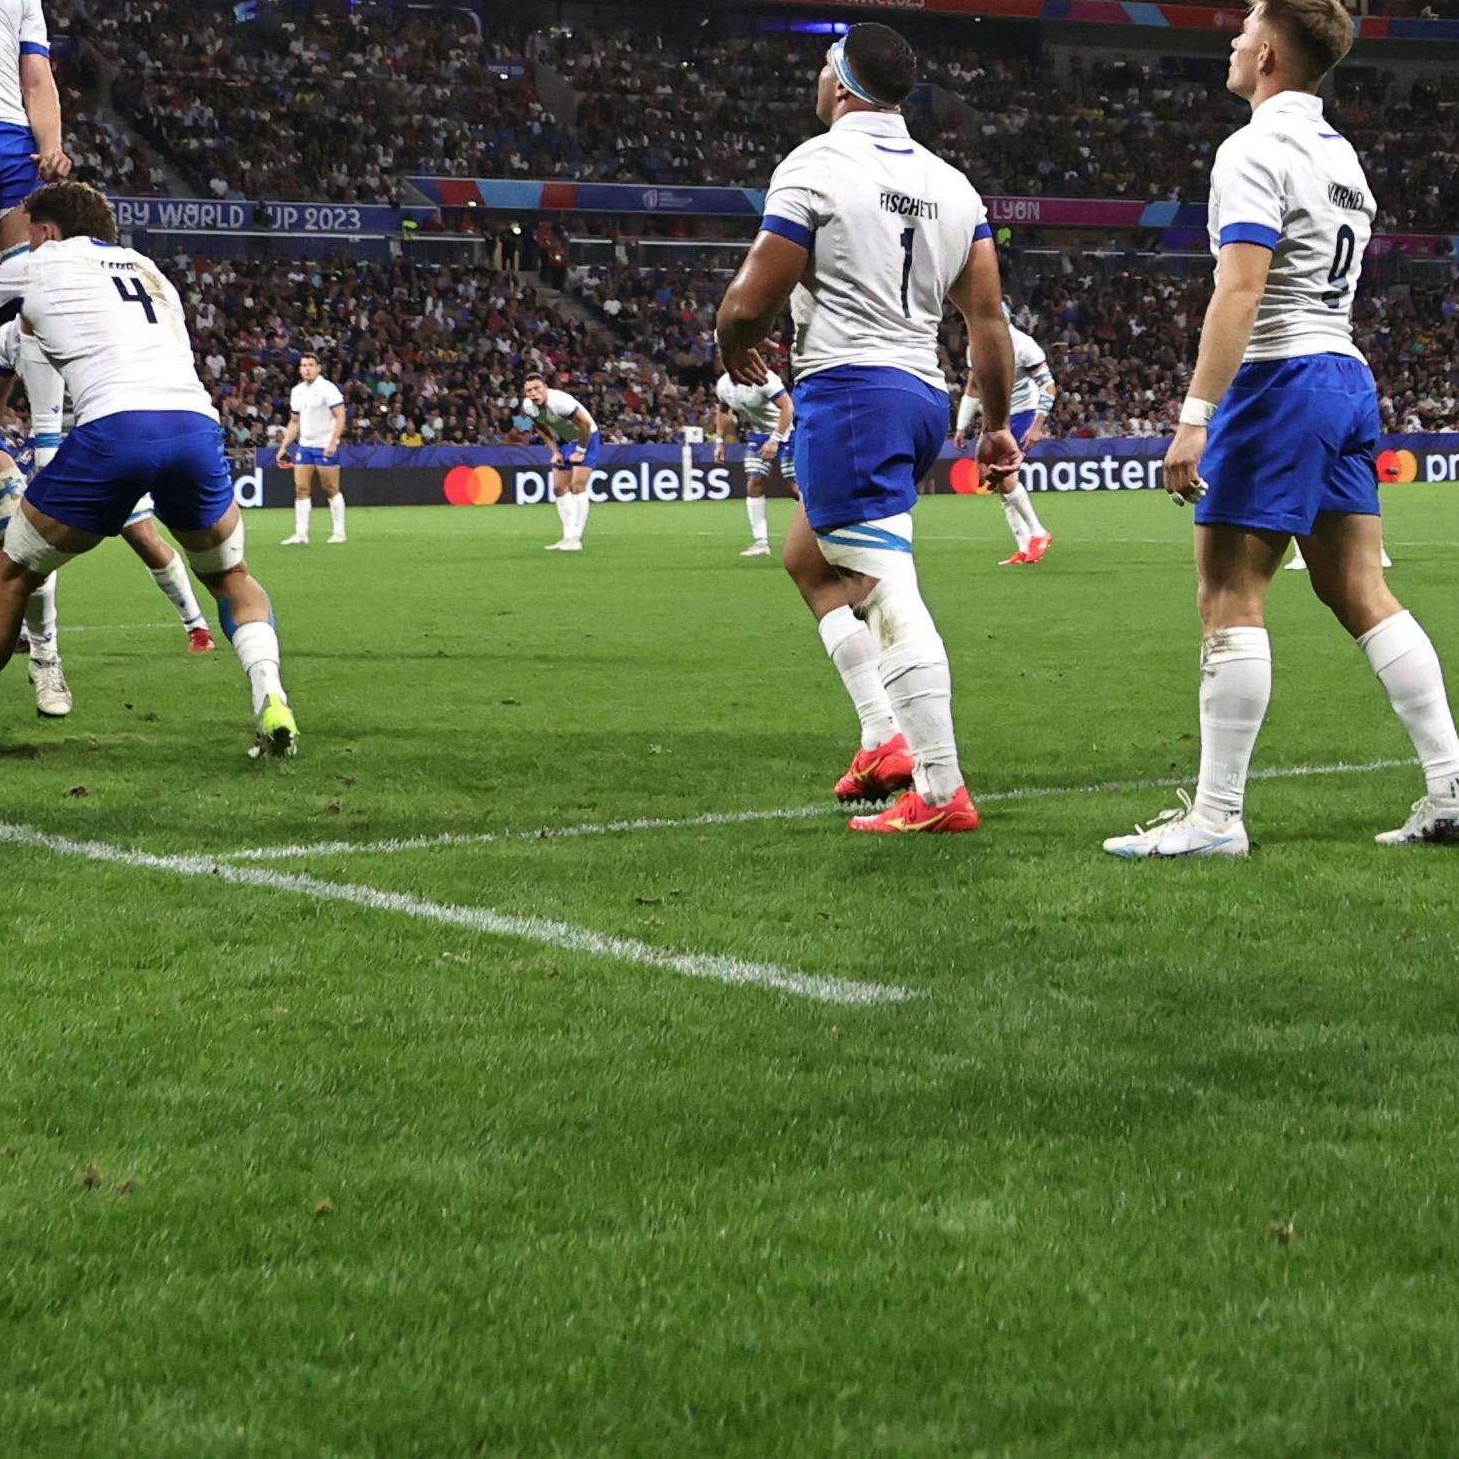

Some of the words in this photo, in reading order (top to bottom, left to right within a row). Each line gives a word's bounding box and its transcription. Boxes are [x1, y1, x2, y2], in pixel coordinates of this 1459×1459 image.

[157, 204, 245, 228] WORLD
[303, 207, 361, 230] 2023
[992, 200, 1041, 221] LYON
[899, 227, 916, 319] 1
[110, 276, 158, 325] 4
[1017, 455, 1165, 492] master
